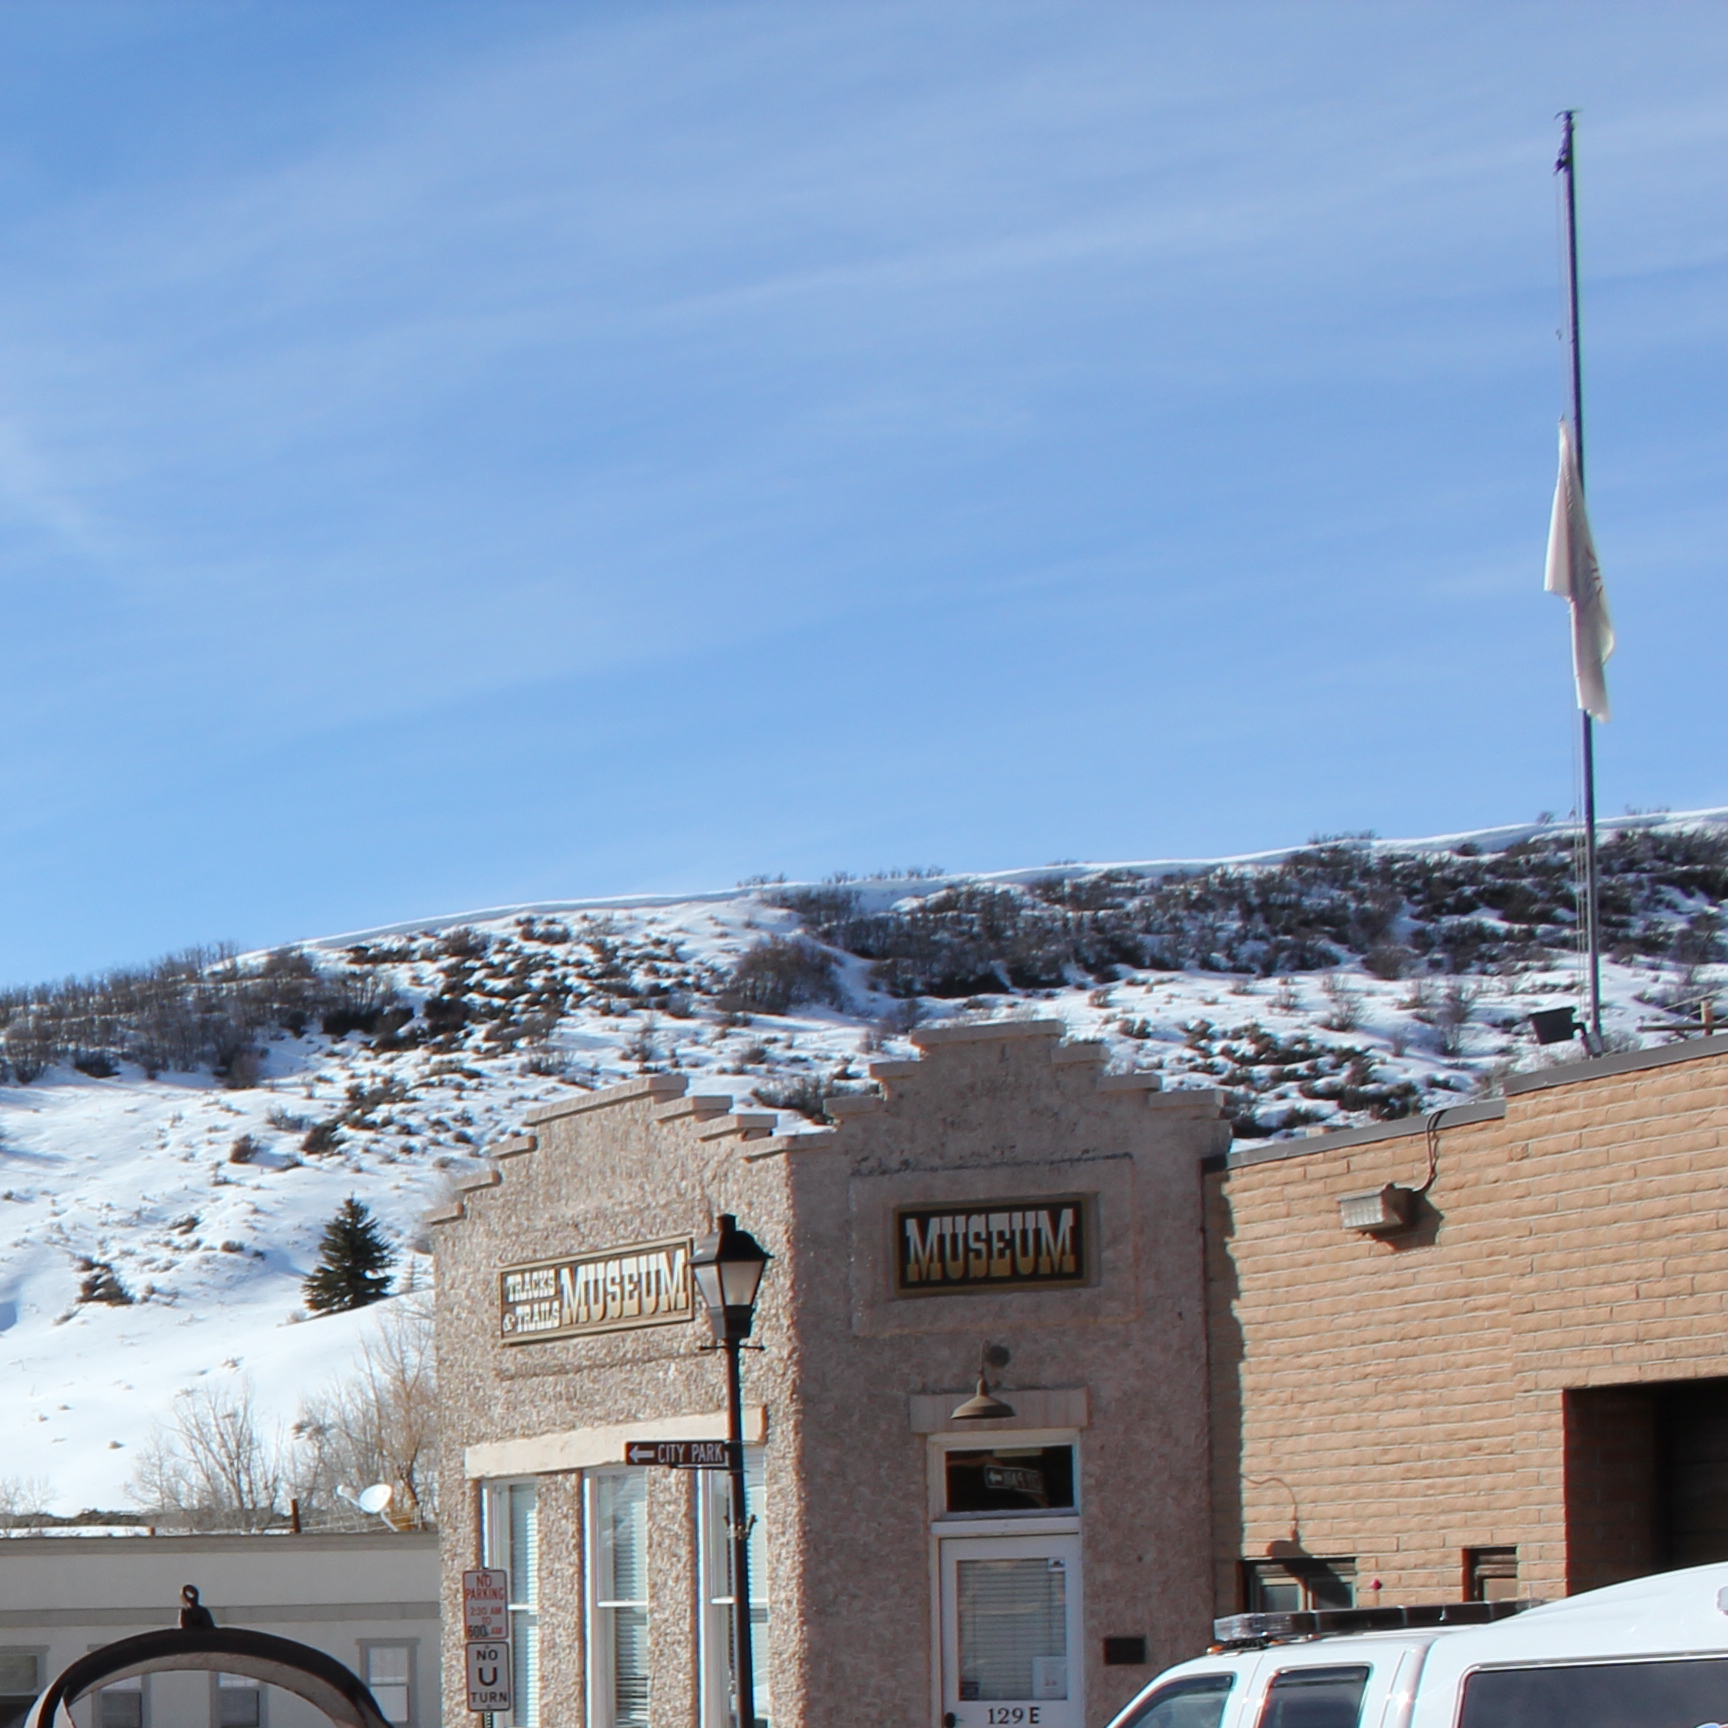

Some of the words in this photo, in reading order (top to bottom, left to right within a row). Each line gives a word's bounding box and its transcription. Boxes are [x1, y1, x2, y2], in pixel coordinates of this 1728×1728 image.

[905, 1207, 1076, 1282] MUSEUM
[506, 1268, 557, 1303] TRACKS
[560, 1247, 689, 1326] MUSEUM
[502, 1311, 516, 1332] &
[515, 1299, 560, 1334] TRAILS
[657, 1443, 685, 1463] CITY
[691, 1443, 723, 1462] PARK
[476, 1574, 492, 1588] NO
[465, 1587, 505, 1601] PARKING
[476, 1649, 498, 1661] NO
[478, 1666, 498, 1687] U
[470, 1691, 508, 1703] TURN
[987, 1707, 1024, 1725] 129
[1029, 1706, 1041, 1724] E
